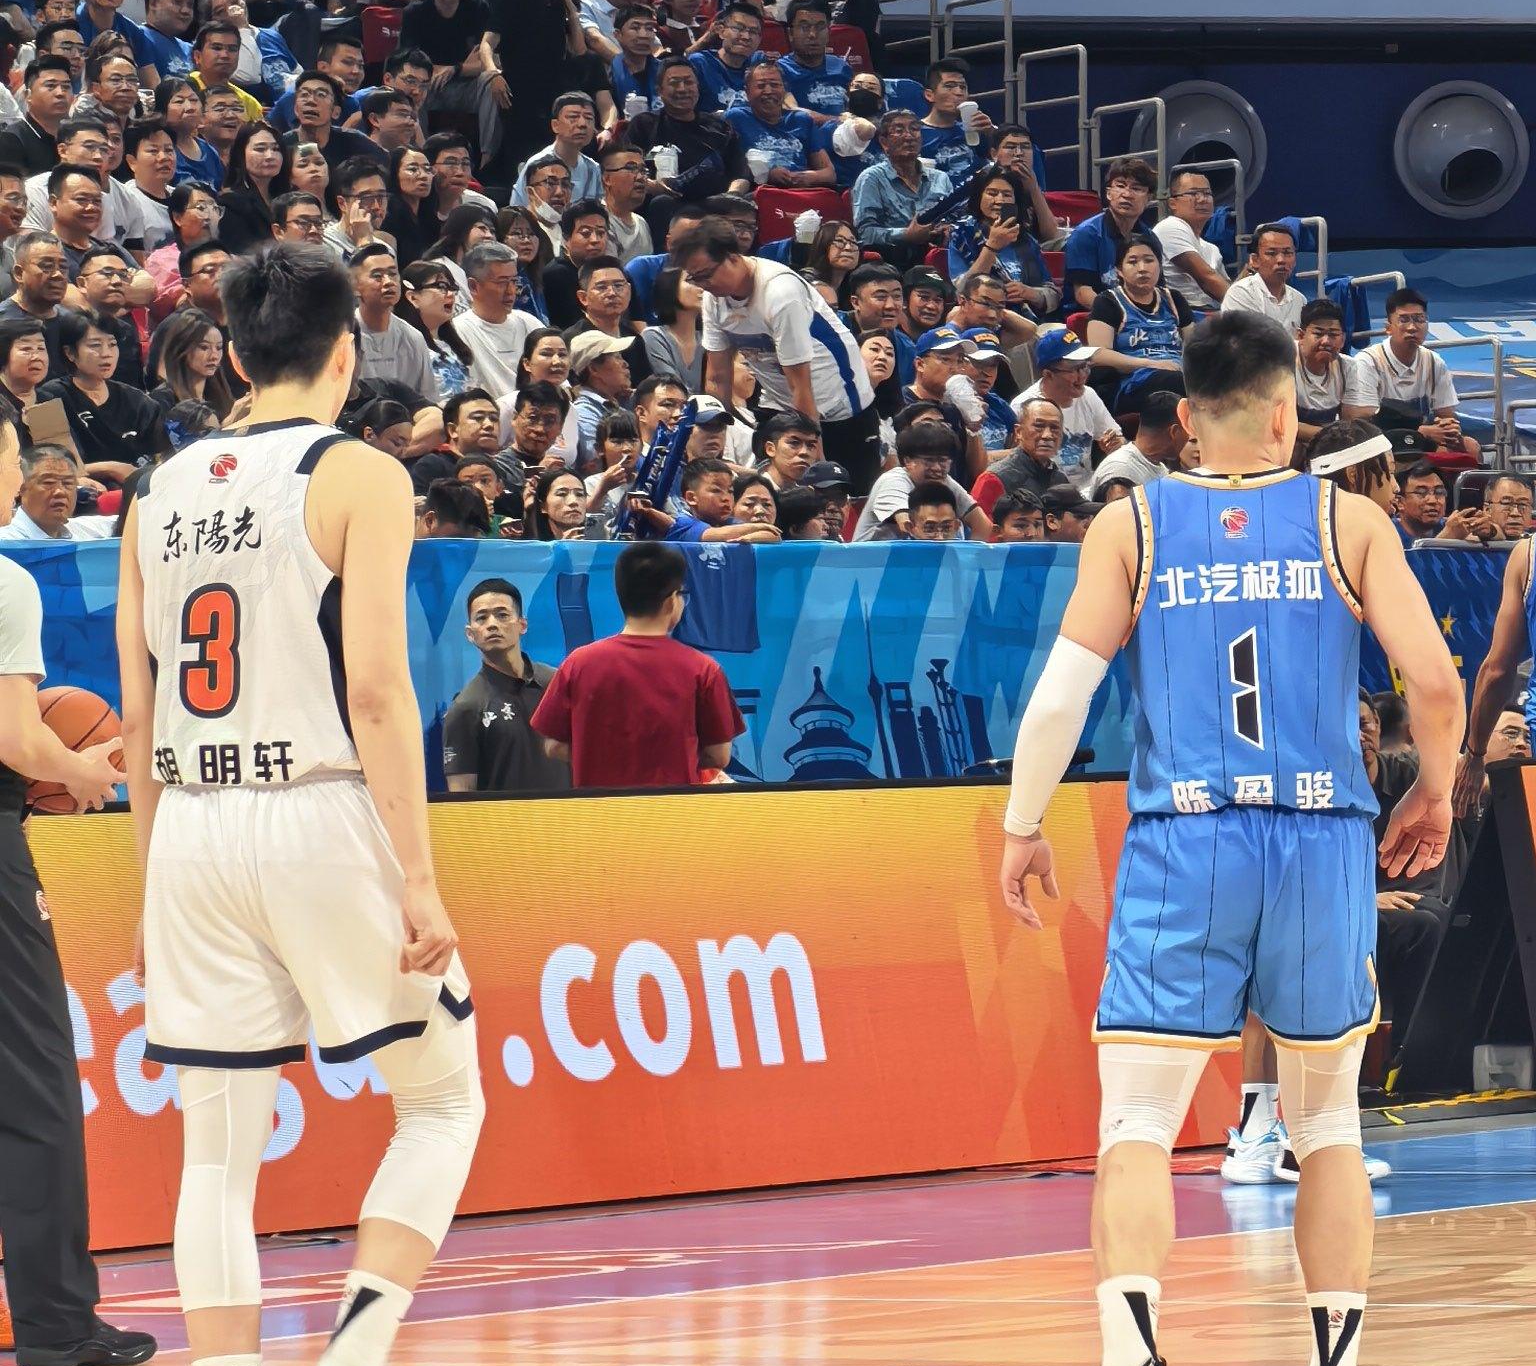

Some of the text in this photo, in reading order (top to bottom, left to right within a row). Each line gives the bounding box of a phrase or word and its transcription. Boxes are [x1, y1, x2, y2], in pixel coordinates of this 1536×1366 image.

[1156, 559, 1324, 609] 北汽极狐
[178, 582, 242, 719] 3
[1228, 625, 1265, 751] 1
[154, 740, 294, 787] 胡明轩
